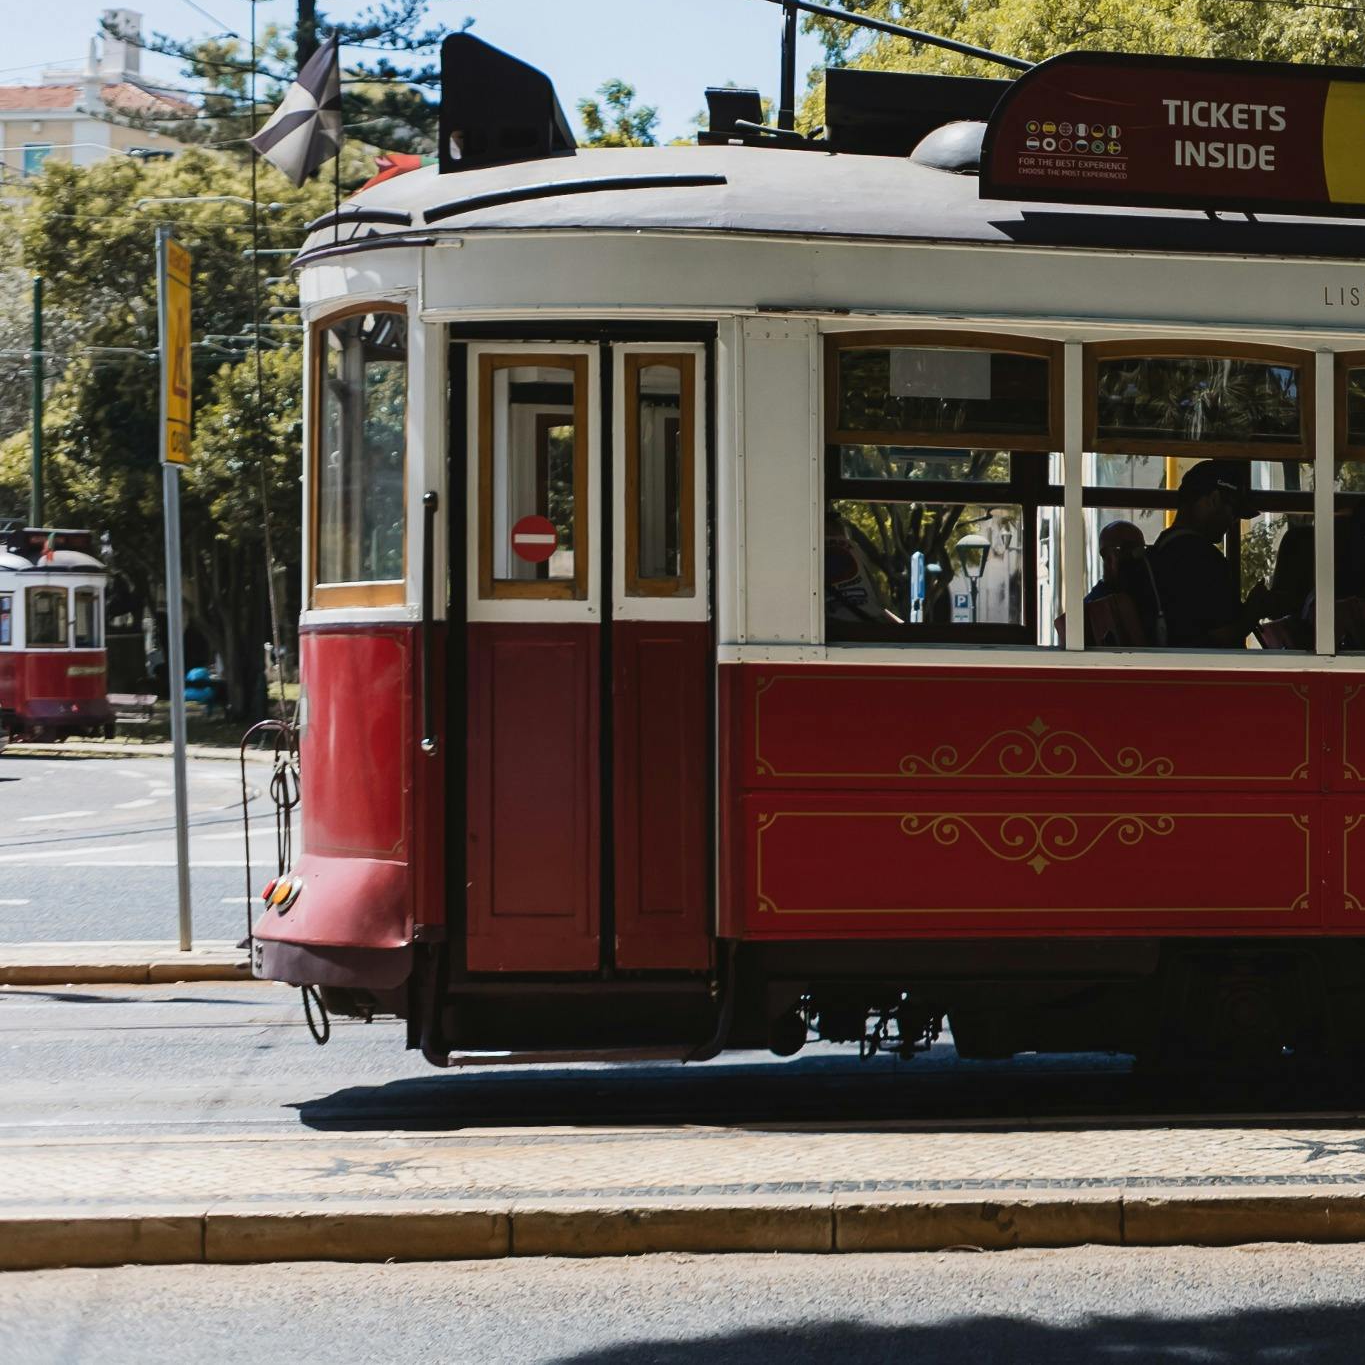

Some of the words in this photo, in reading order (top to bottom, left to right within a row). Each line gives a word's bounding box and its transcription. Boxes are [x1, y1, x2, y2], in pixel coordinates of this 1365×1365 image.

[1162, 99, 1288, 132] TICKETS
[1018, 156, 1035, 166] FOR
[1038, 158, 1054, 167] THE
[1055, 159, 1076, 168] BEST
[1078, 160, 1127, 171] EXPERIENCE
[1174, 139, 1276, 171] INSIDE
[1018, 167, 1045, 175] CHOOSE
